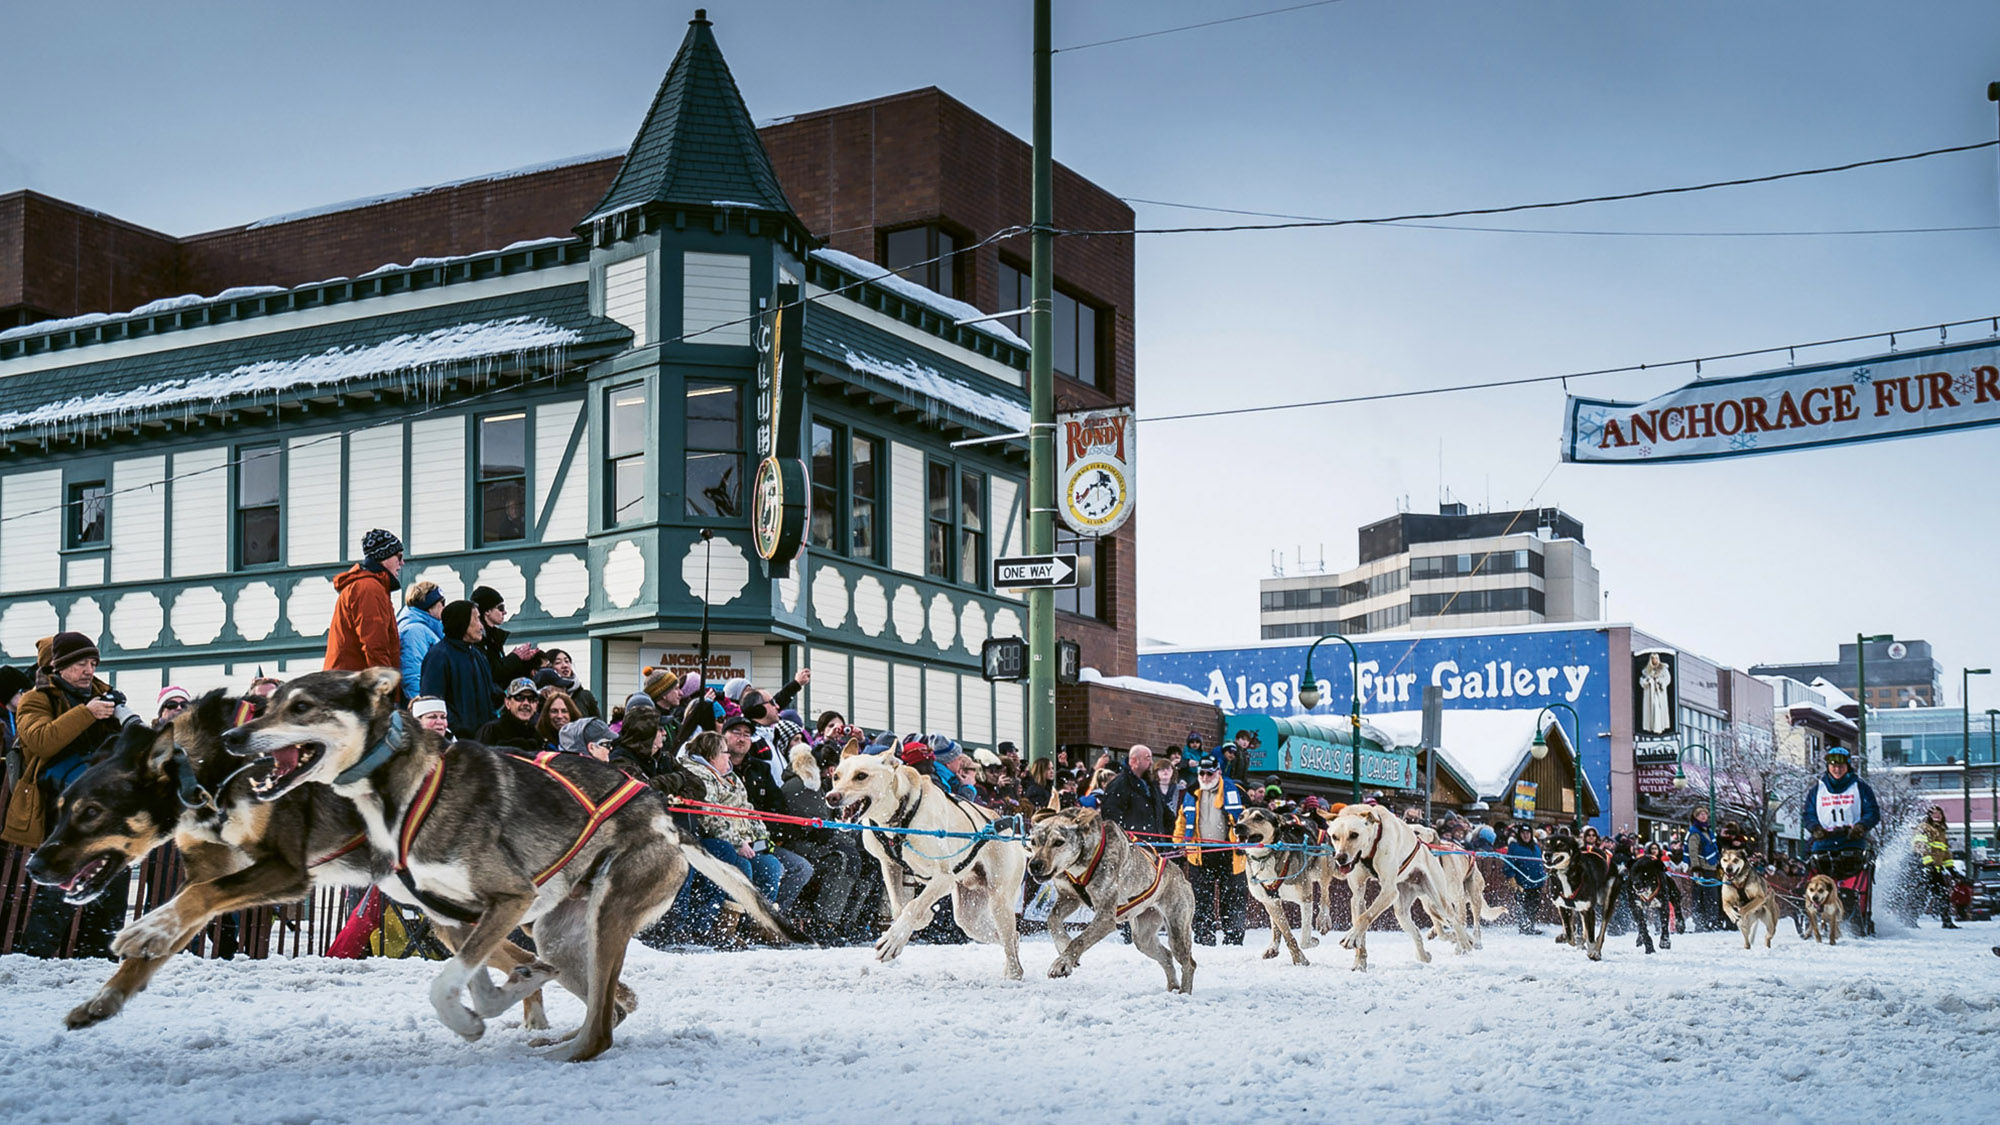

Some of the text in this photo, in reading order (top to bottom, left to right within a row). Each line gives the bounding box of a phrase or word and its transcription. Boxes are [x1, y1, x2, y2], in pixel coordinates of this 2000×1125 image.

[757, 325, 771, 456] CLUB
[1598, 384, 1861, 449] ANCHORAGE
[1872, 371, 1961, 418] FUR
[1064, 415, 1130, 473] RONDY
[1003, 565, 1053, 579] ONE WAY
[660, 653, 731, 667] ANCHOAGE
[1349, 660, 1417, 703] Fur
[1431, 660, 1590, 702] Gallery
[1300, 743, 1399, 782] SARA'S GIT CACHE
[1831, 808, 1845, 822] 11
